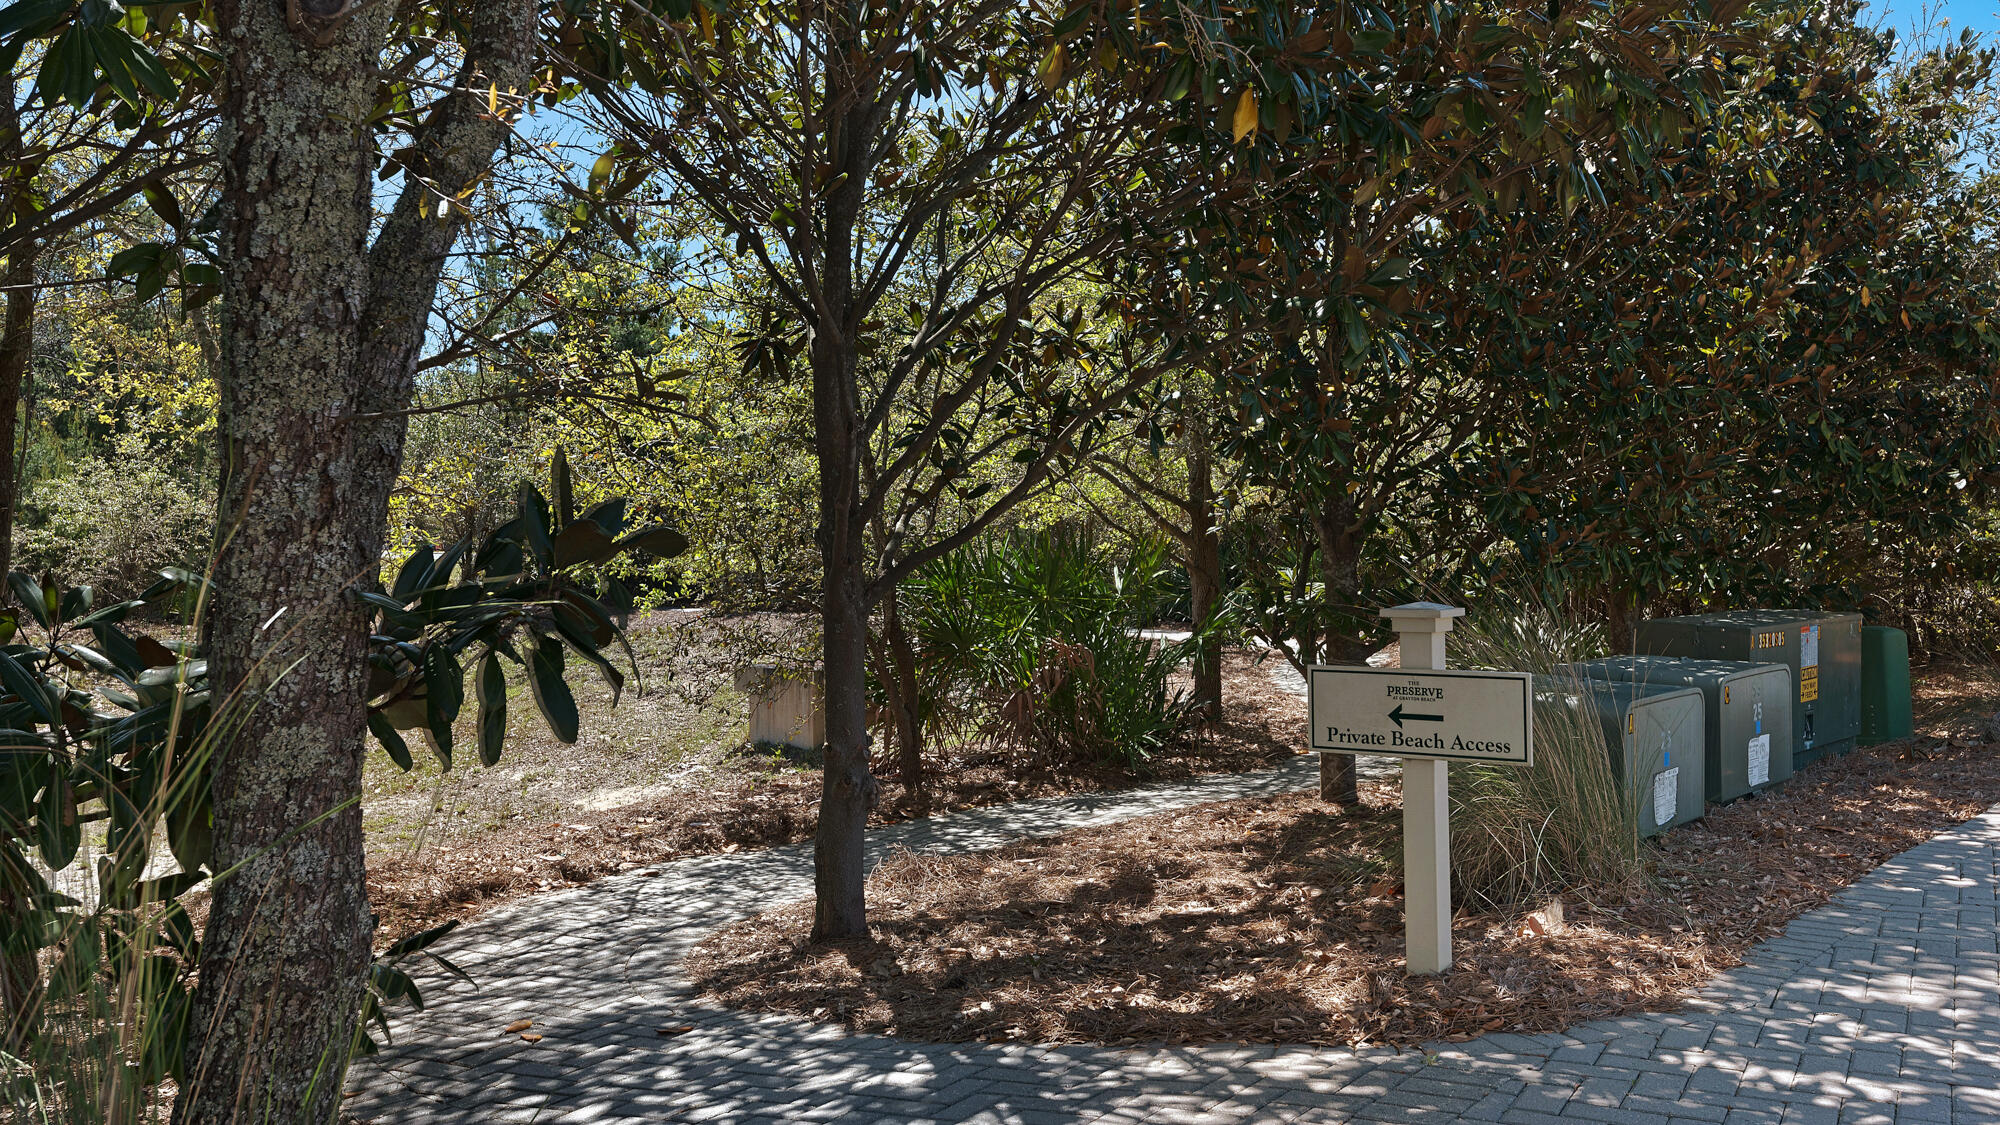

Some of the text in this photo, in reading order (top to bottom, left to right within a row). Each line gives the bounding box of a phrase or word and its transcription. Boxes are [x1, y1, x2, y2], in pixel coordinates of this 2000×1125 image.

[1386, 685, 1444, 699] PRESERVE
[1753, 702, 1762, 721] 25
[1326, 726, 1511, 753] Private Beach Access
